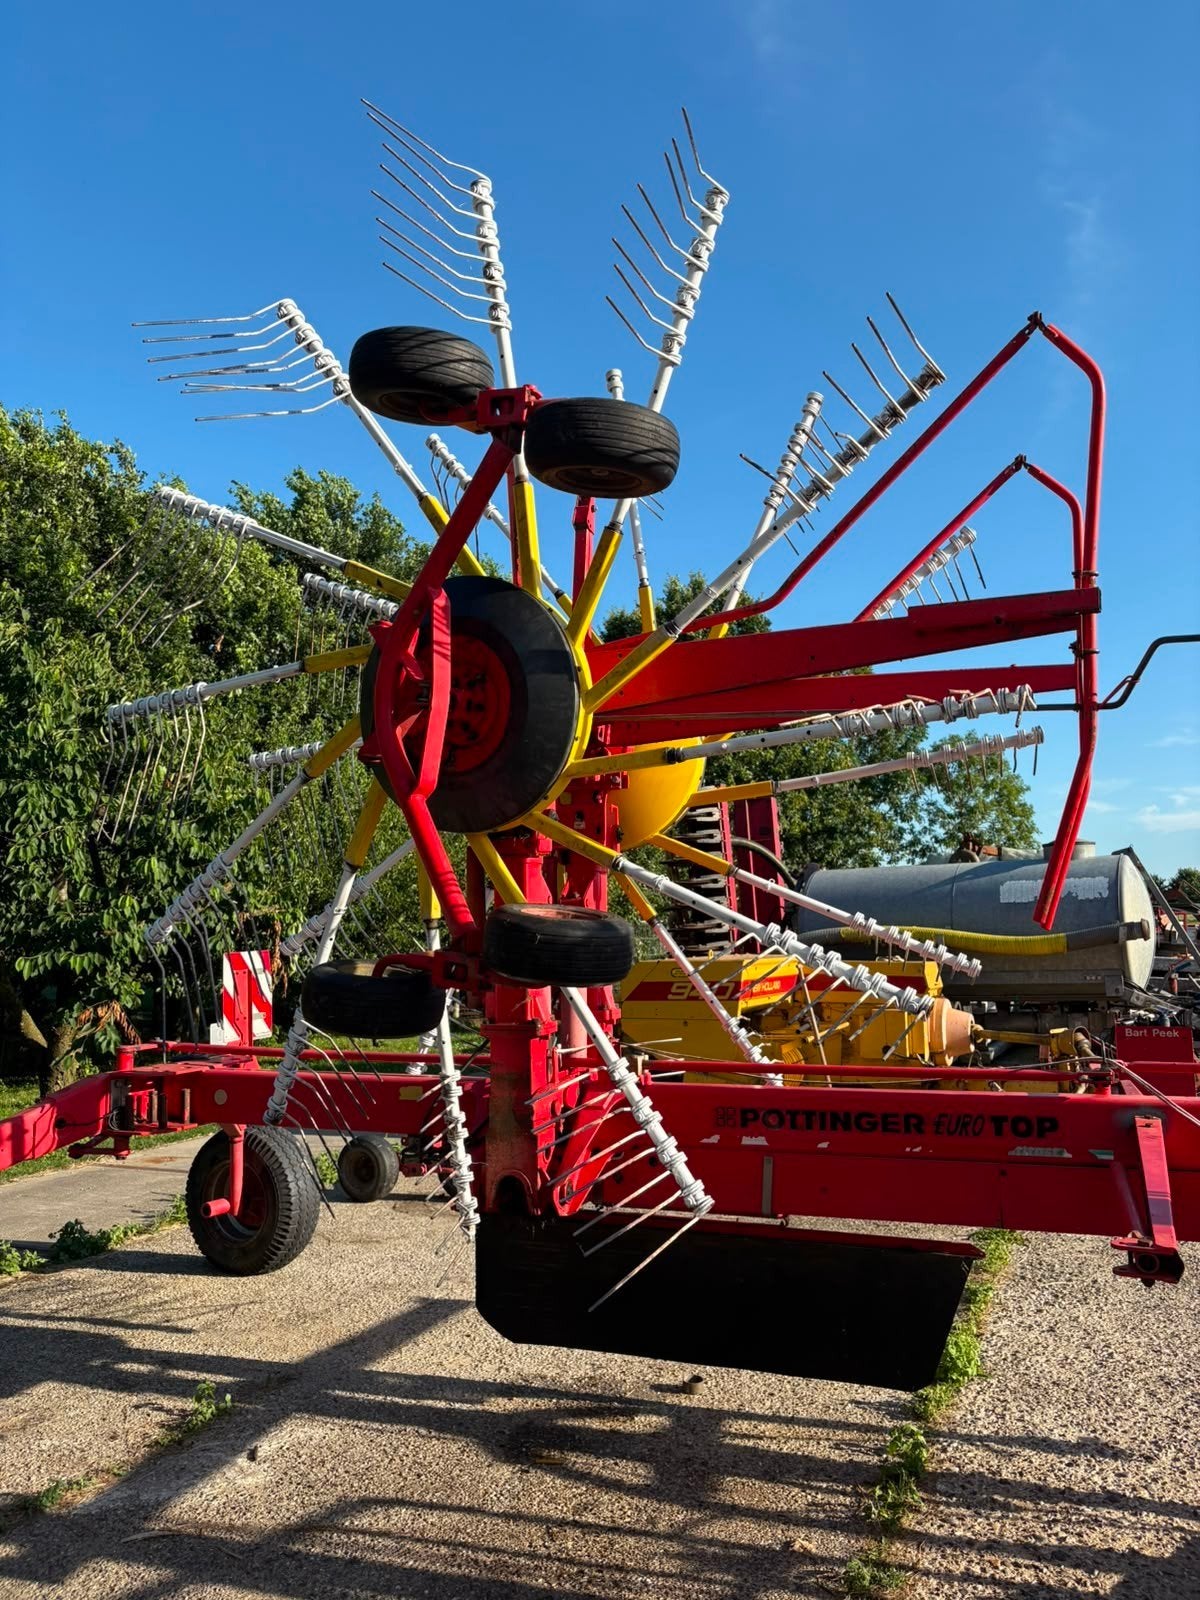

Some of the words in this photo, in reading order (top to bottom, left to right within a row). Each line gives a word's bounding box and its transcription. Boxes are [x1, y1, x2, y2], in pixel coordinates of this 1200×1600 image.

[1125, 1028, 1147, 1037] Bart
[1152, 1029, 1179, 1038] Peek
[990, 1115, 1059, 1138] TOP
